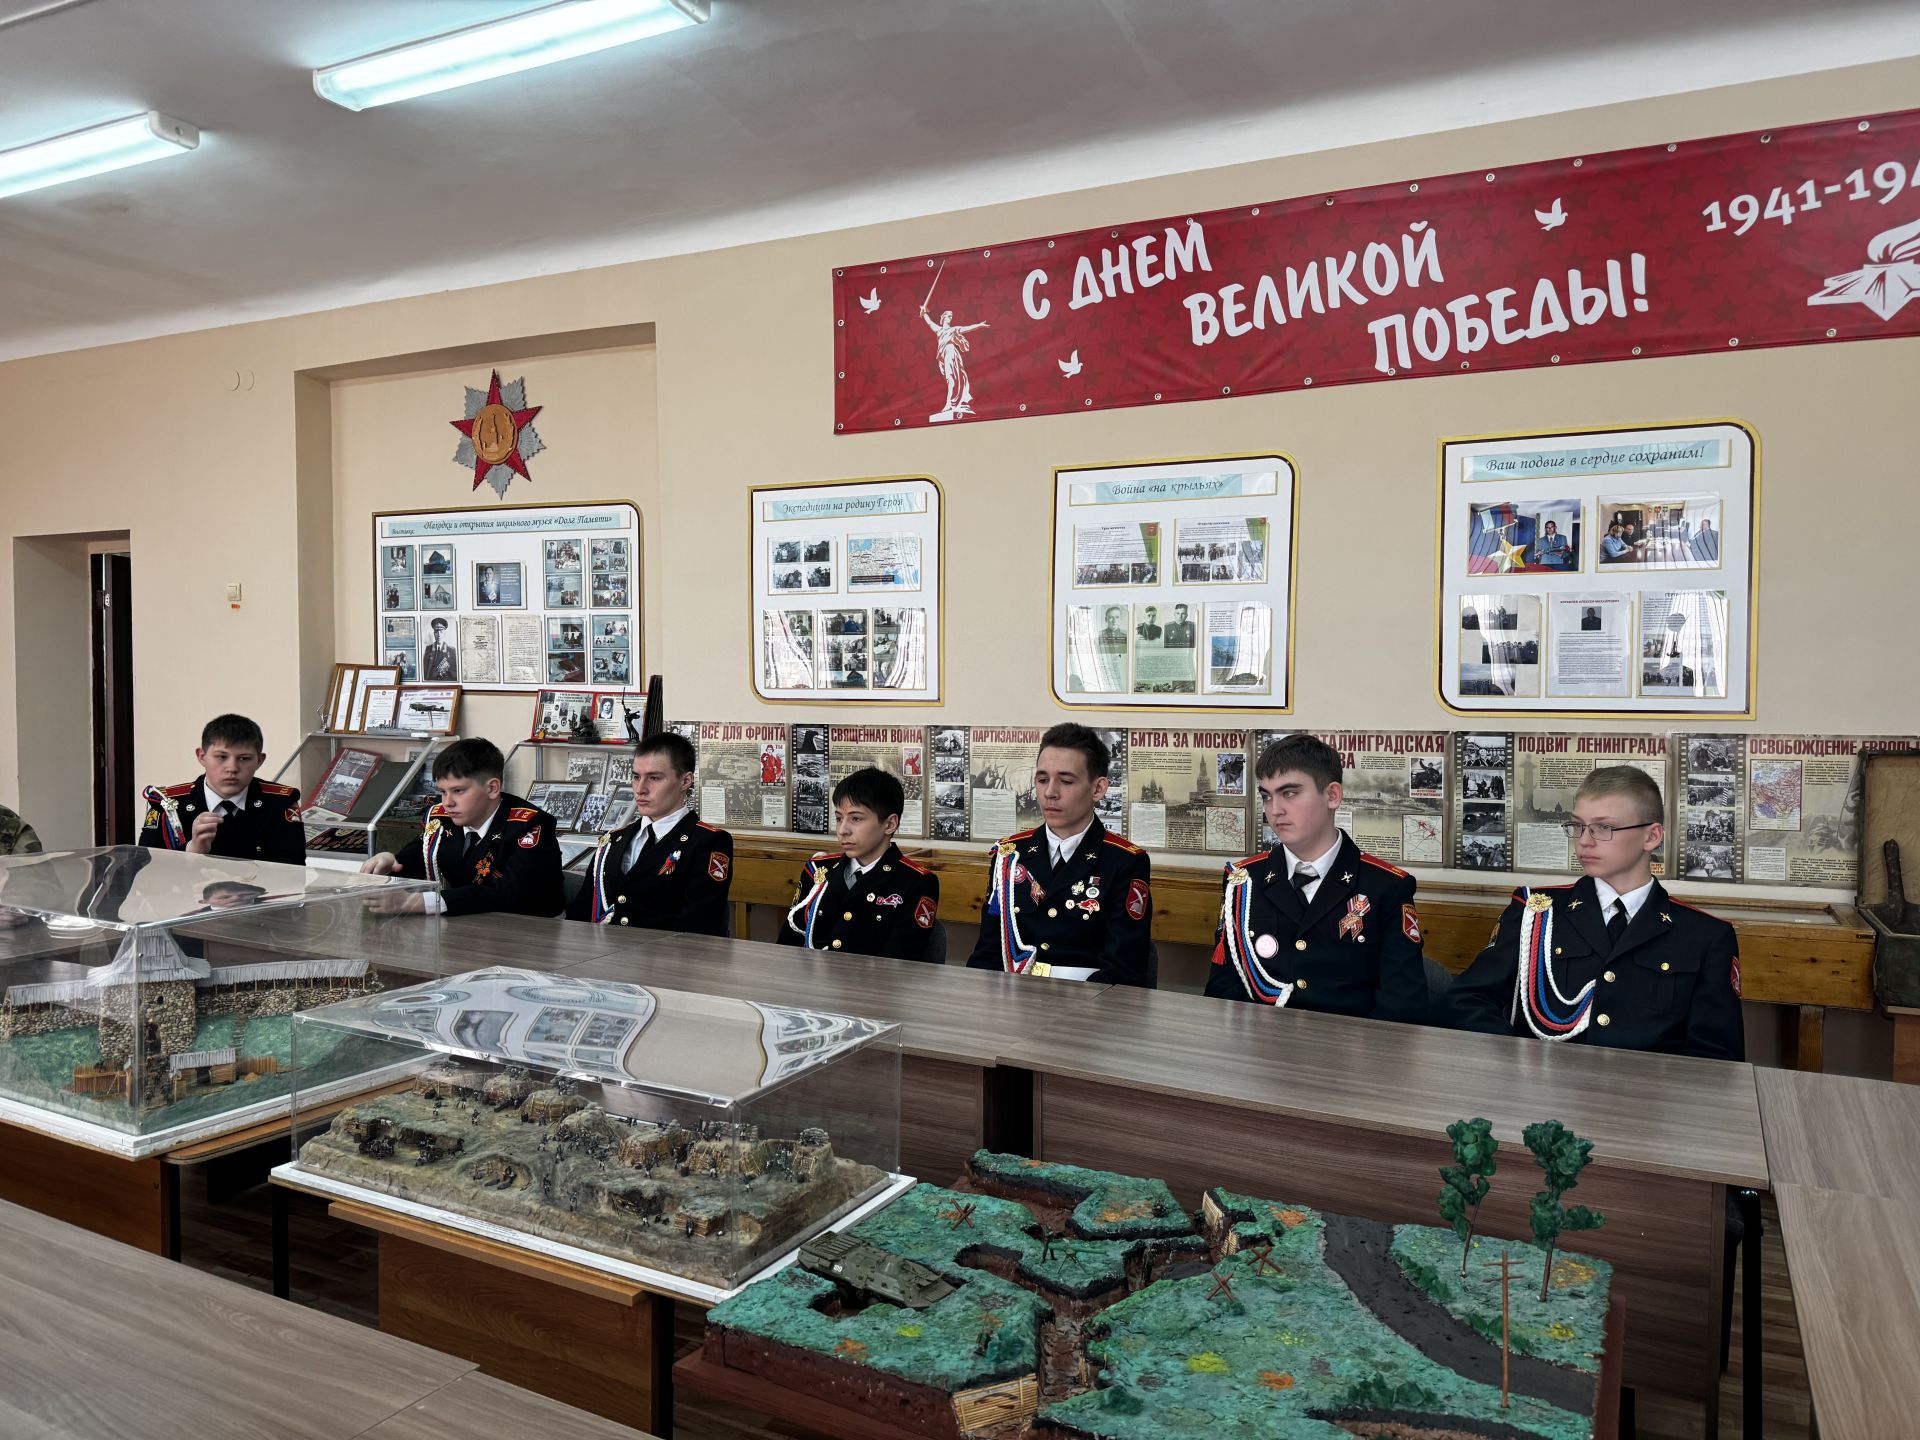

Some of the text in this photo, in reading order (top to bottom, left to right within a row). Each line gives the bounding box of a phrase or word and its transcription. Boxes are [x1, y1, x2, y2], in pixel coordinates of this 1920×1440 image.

[1021, 221, 1213, 320] С ДНЕМ
[1182, 220, 1445, 347] ВЕЛИКОЙ
[1366, 252, 1650, 373] ПОБЕДЫ!
[1485, 445, 1705, 472] Ваш подвиг в сердце сохраним!
[1111, 480, 1225, 496] Война «на крыльях»
[782, 503, 832, 515] Экспедиции
[832, 502, 844, 510] на
[844, 499, 876, 513] родину
[496, 519, 531, 529] школьного
[531, 518, 553, 528] музея
[722, 725, 742, 742] ДЛЯ
[745, 726, 786, 741] ФРОНТА
[830, 727, 923, 744] СВЯЩЕННАЯ ВОЙНА
[972, 728, 1040, 744] ПАРТИЗАНСКИЙ
[1130, 731, 1247, 749] БИТВА ЗА МОСКВУ
[1518, 736, 1667, 756] ПОДВИГ ЛЕНИНГРАДА
[1749, 738, 1857, 757] ОСВОБОЖДЕНИЕ
